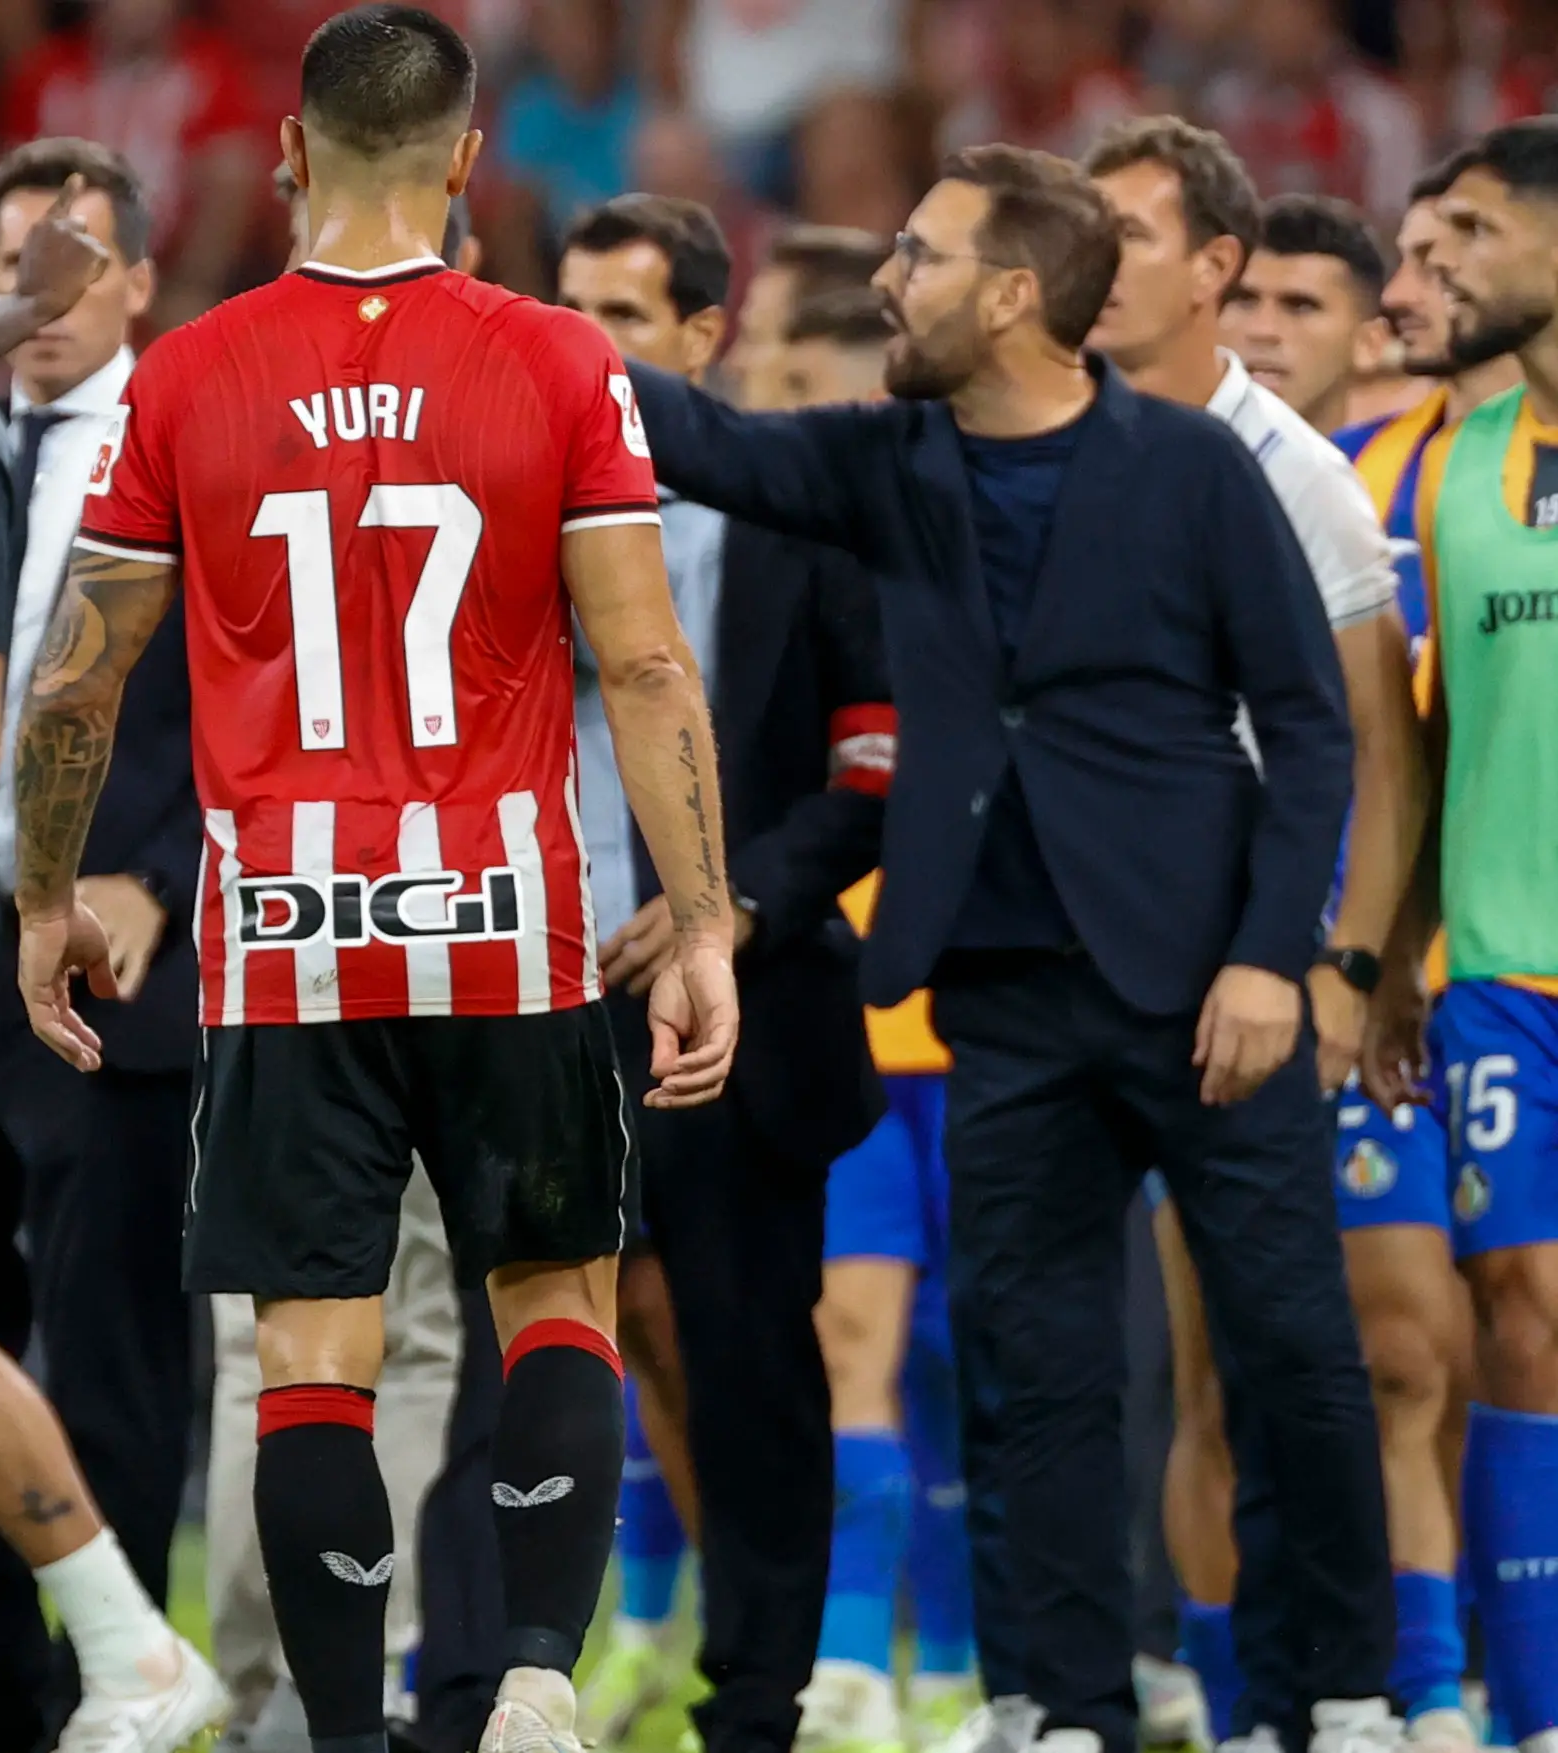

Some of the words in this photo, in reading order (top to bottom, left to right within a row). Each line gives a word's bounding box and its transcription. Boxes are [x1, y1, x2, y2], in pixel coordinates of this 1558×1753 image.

[287, 383, 425, 450] YURI
[249, 482, 484, 751] 17
[237, 866, 524, 950] DIGI
[1445, 1055, 1517, 1155] 15
